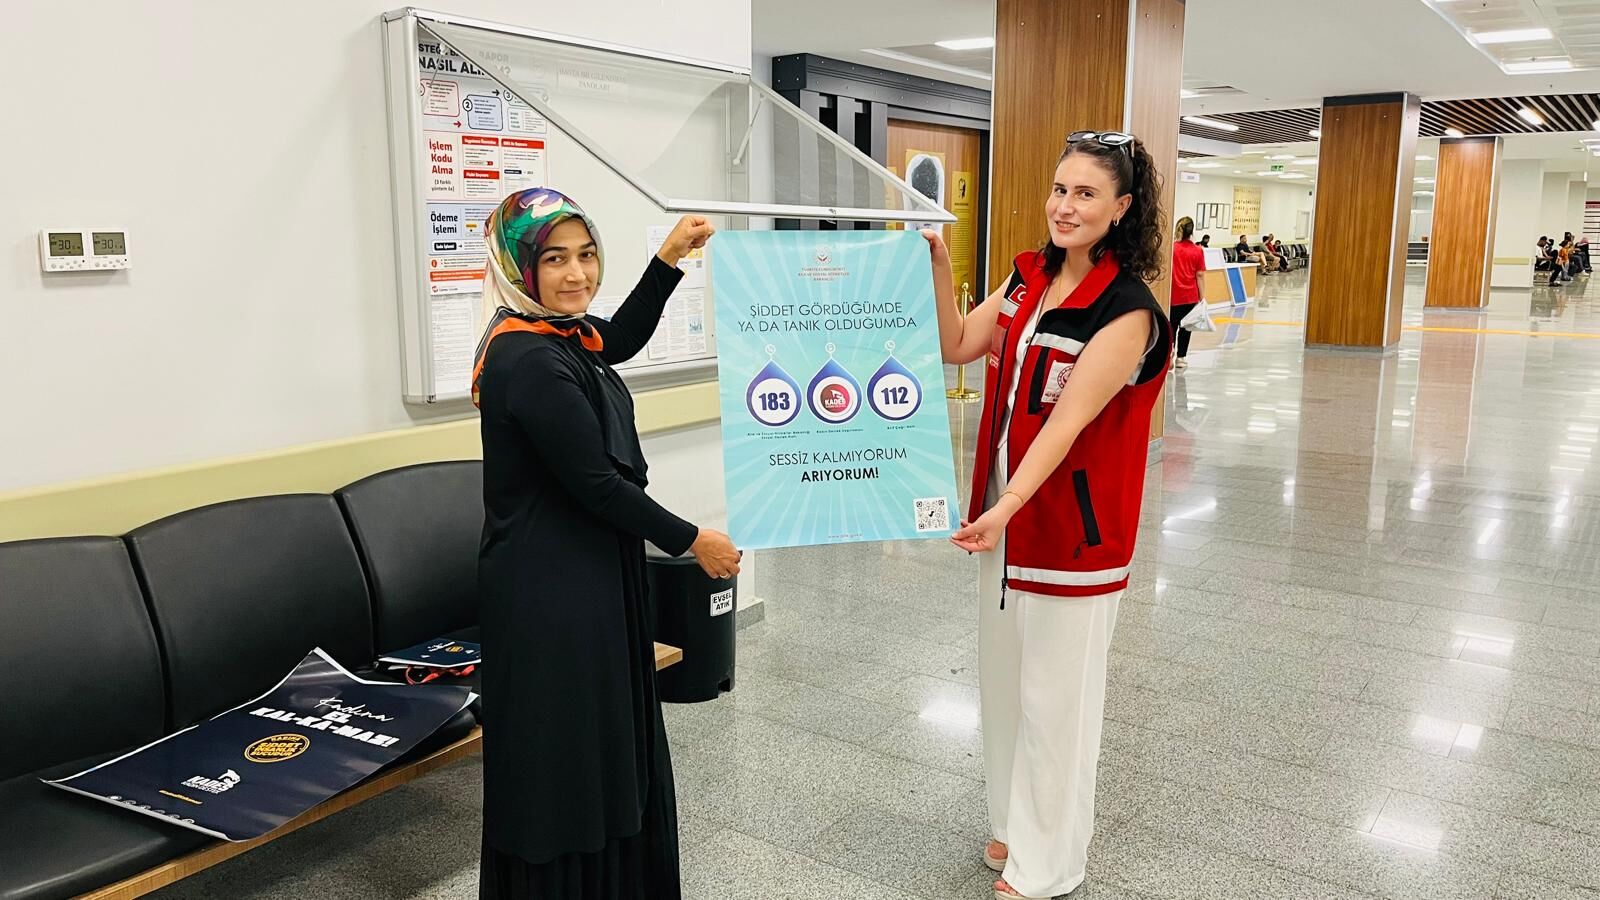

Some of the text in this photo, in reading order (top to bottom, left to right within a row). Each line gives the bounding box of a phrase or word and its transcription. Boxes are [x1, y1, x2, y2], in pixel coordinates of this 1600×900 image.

[418, 57, 457, 73] NASIL
[429, 139, 453, 152] İşlem
[431, 153, 453, 163] Kodu
[431, 165, 453, 175] Alma
[430, 211, 458, 223] Ödeme
[432, 222, 457, 235] İşlemi
[58, 239, 71, 250] 30
[101, 239, 114, 249] 30
[750, 301, 903, 318] ŞİDDET GÖRDÜĞÜMDE
[738, 316, 917, 333] YA DA TANIK OLDUĞUMDA
[758, 392, 790, 411] 183
[881, 387, 909, 405] 112
[769, 448, 907, 466] SESSİZ KALMIYORUM
[801, 469, 879, 483] ARIYORUM!
[713, 592, 732, 603] EVSEL
[715, 600, 730, 611] ATIK
[314, 697, 394, 722] Kadına
[322, 711, 352, 724] EL
[249, 707, 400, 748] KAL-KA-MAZ!
